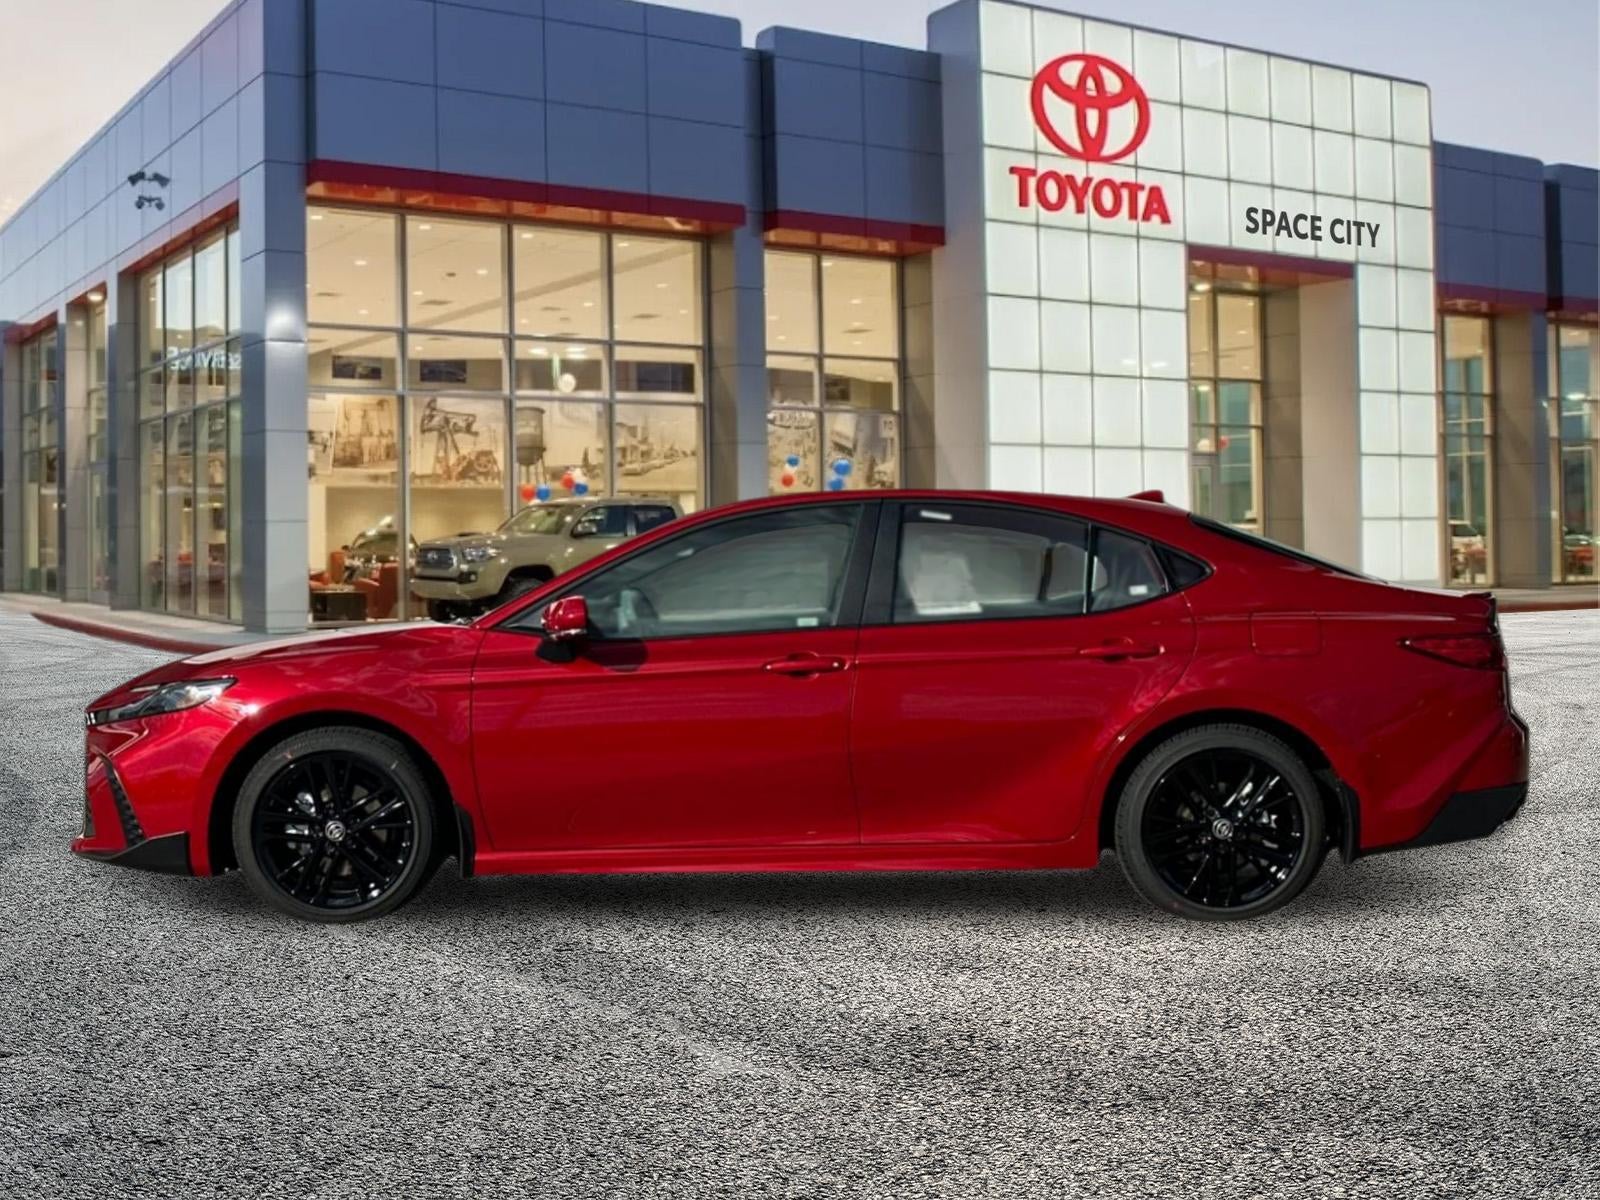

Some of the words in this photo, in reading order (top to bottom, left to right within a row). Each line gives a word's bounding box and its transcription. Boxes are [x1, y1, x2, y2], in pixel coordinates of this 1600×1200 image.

[1009, 166, 1171, 224] TOYOTA
[1245, 206, 1322, 241] SPACE
[1329, 217, 1380, 247] CITY
